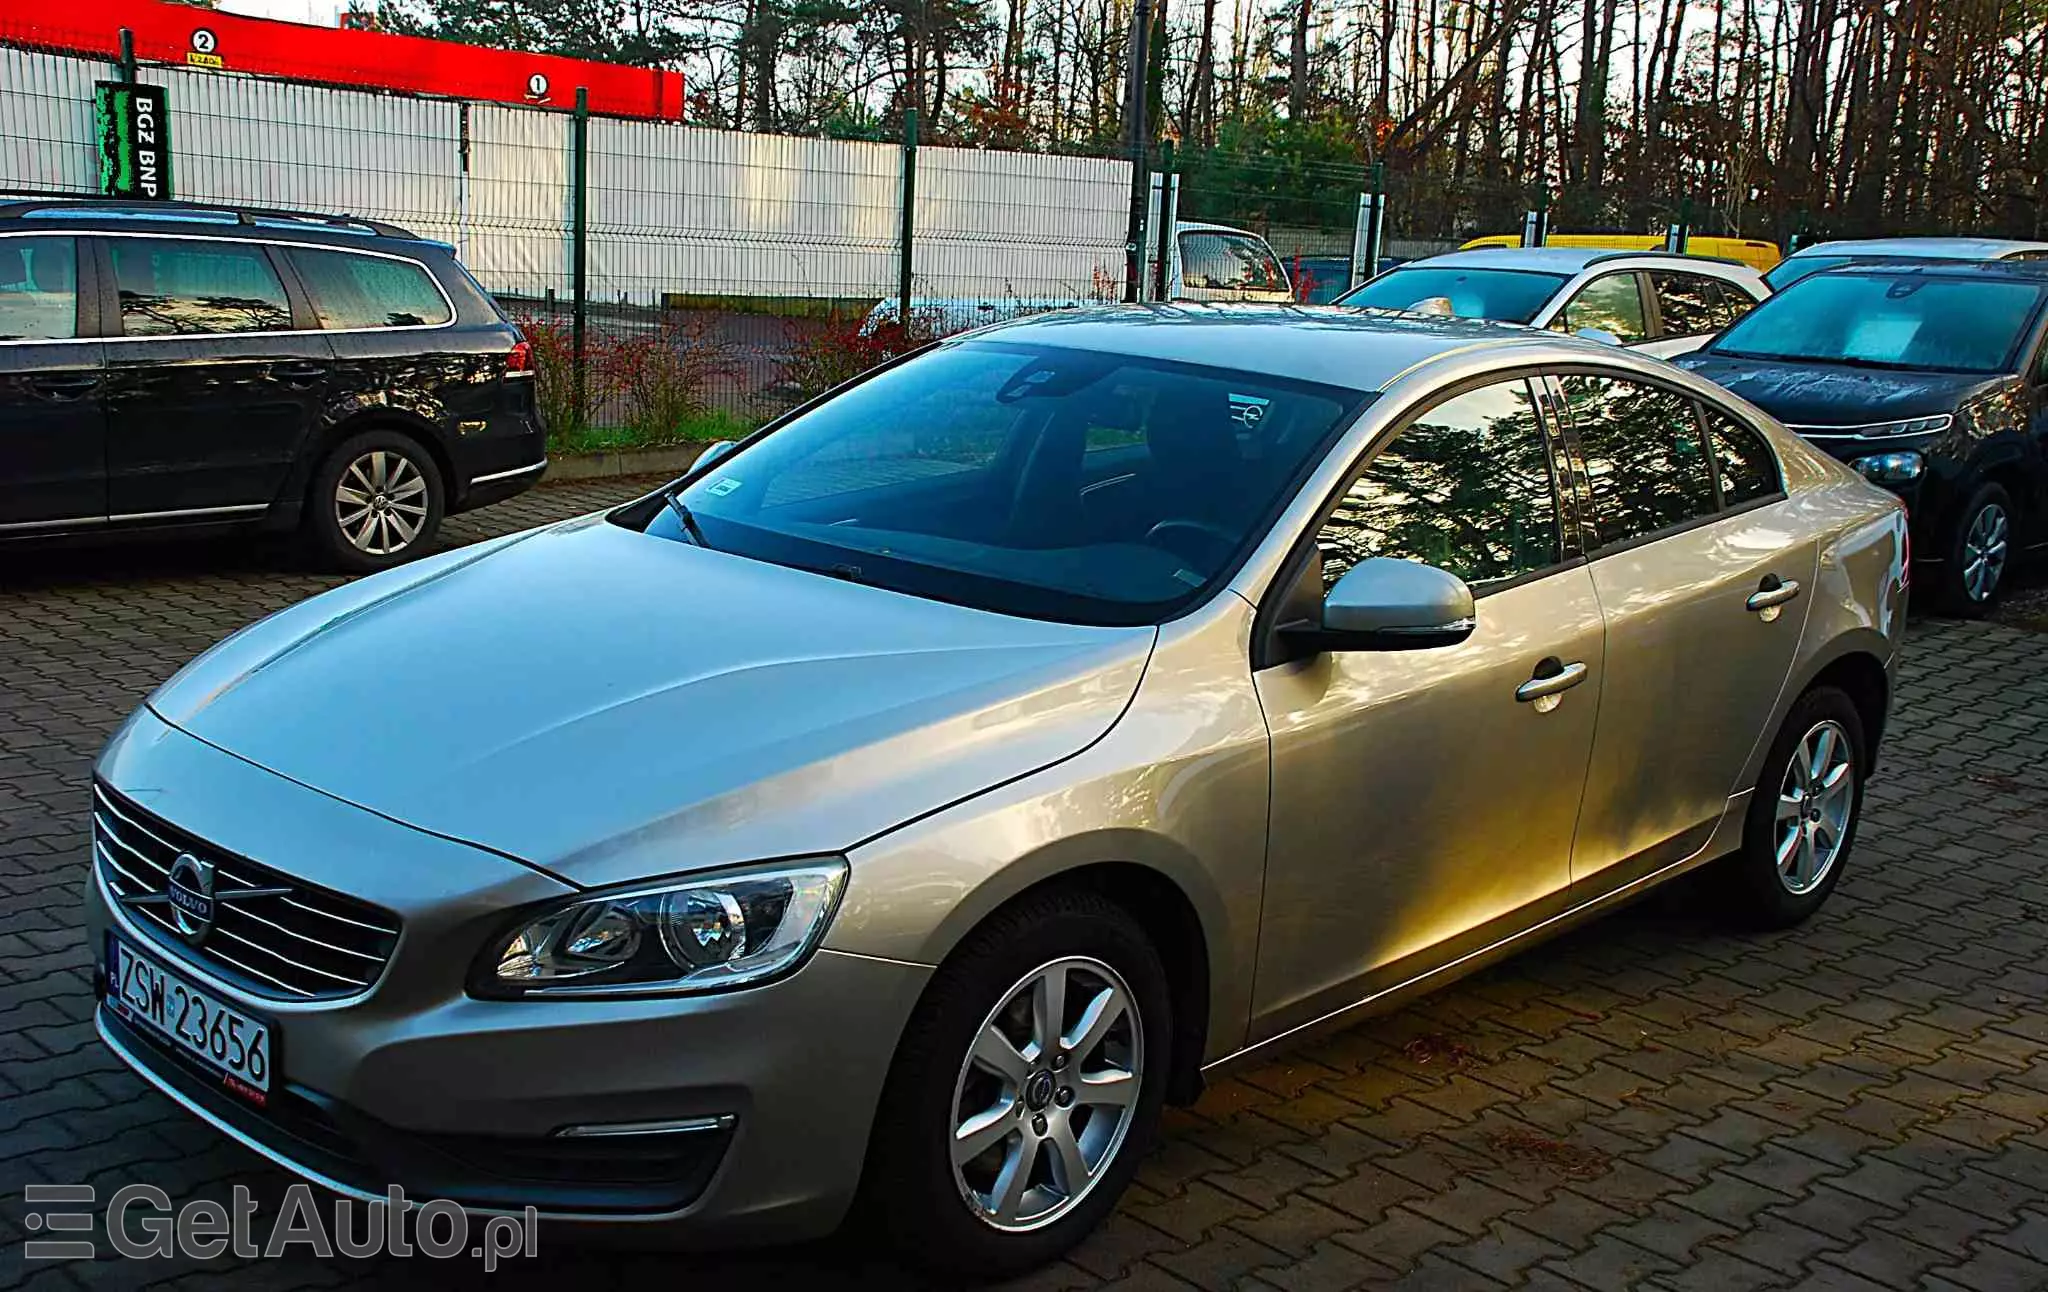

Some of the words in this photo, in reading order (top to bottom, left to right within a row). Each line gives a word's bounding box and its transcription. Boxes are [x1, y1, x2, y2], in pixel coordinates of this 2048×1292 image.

[198, 34, 209, 49] 2
[139, 151, 157, 197] BNP
[170, 885, 207, 914] VOLVO
[120, 949, 165, 1026] ZSW
[174, 985, 266, 1082] 23656
